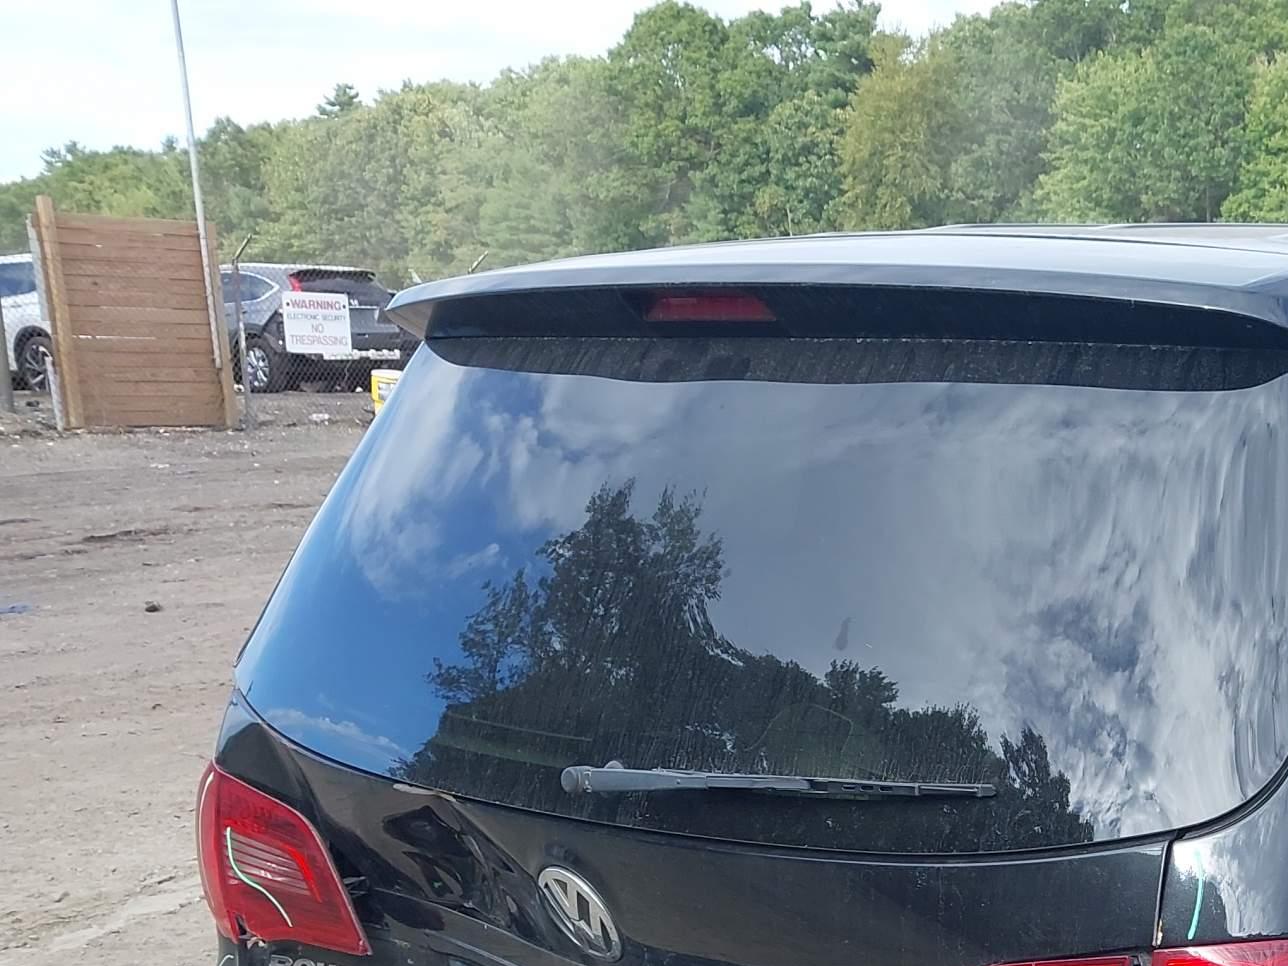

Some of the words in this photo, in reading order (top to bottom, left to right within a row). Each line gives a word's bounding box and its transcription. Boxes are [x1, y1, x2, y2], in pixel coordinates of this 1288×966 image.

[290, 299, 341, 311] WARNING
[311, 323, 325, 333] NO
[290, 335, 347, 346] TRESPASSING
